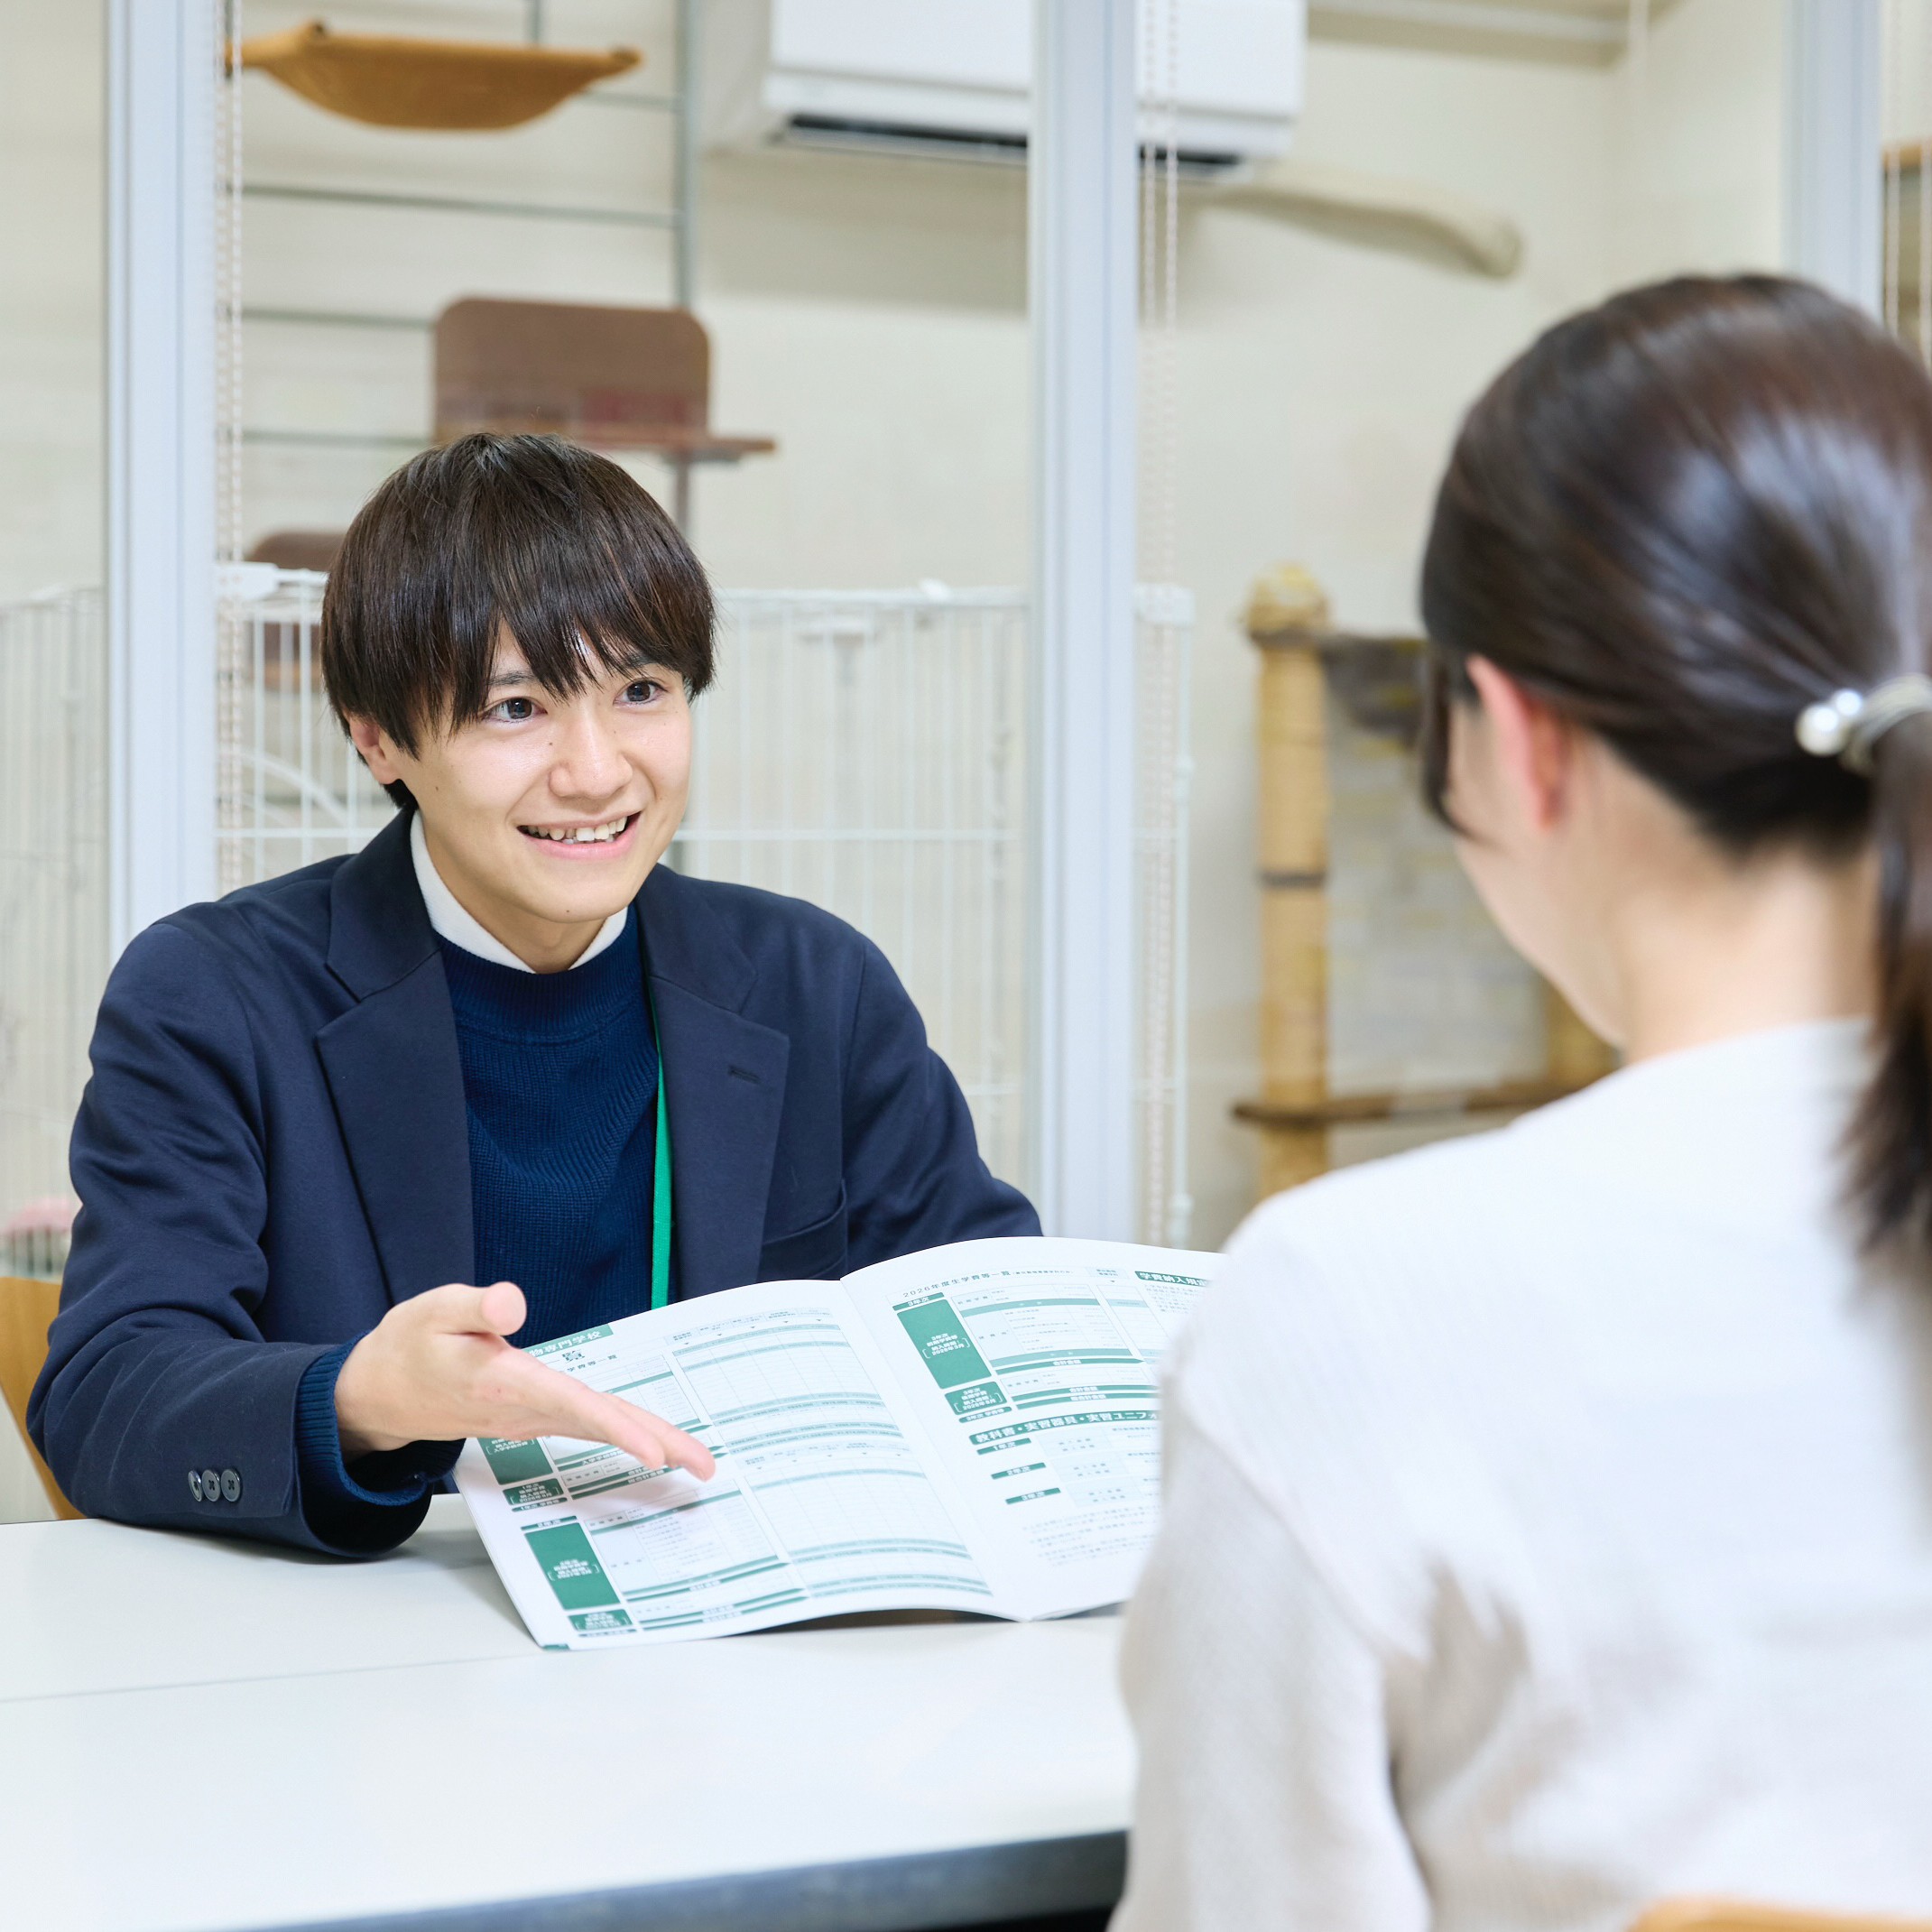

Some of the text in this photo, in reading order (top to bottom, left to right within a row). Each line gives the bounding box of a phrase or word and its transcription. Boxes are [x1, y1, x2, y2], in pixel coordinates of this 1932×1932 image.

[560, 1354, 617, 1373] 学費等一覧
